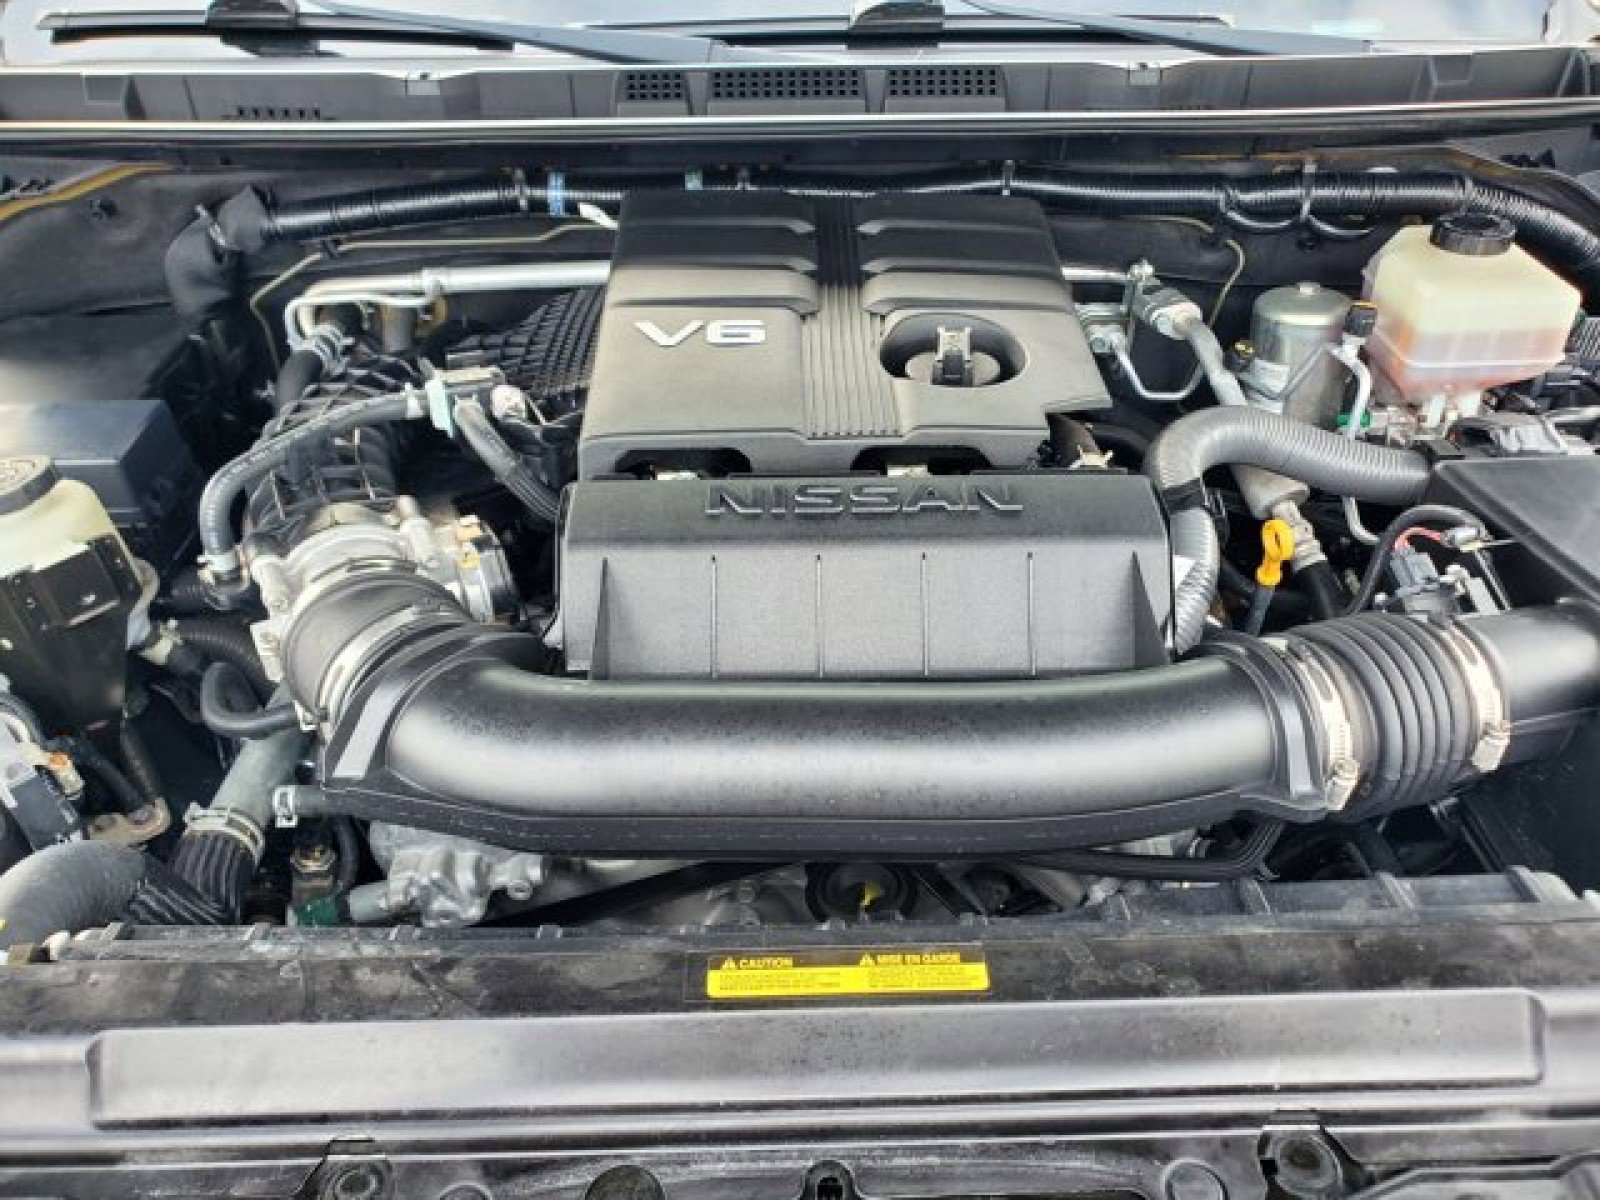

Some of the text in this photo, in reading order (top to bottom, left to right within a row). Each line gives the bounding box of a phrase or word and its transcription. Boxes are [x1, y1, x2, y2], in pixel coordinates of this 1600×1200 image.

[634, 319, 766, 347] V6
[704, 483, 1024, 517] NISSAN
[738, 956, 793, 969] CAUTION
